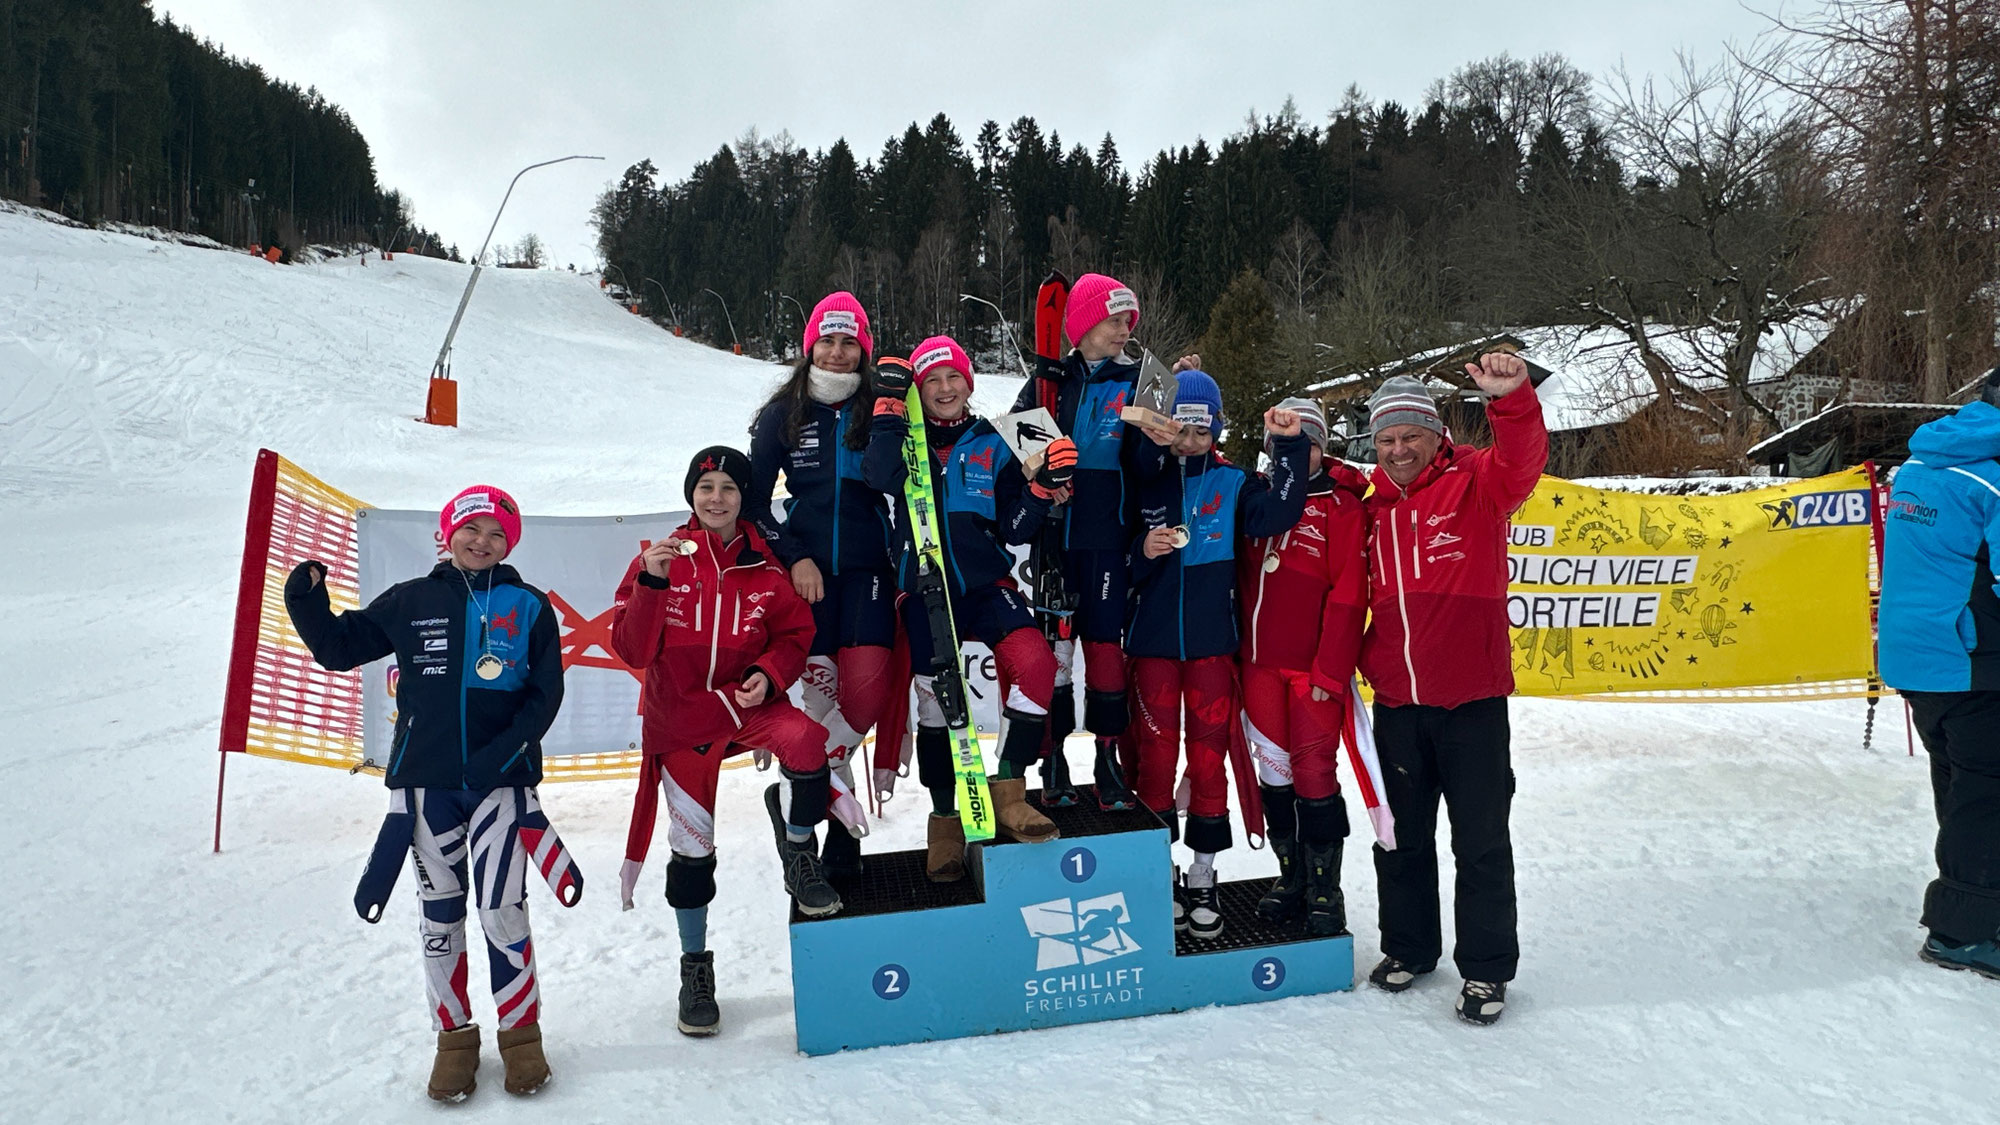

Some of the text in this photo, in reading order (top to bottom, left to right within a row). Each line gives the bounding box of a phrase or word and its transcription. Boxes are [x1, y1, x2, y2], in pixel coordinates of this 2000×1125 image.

[902, 405, 923, 488] FISCHE
[1796, 492, 1867, 526] CLUB
[1507, 527, 1546, 547] UB
[1609, 558, 1692, 585] VIELE
[1070, 853, 1083, 876] 1
[884, 970, 900, 993] 2
[1025, 967, 1144, 997] SCHILIFT
[1261, 963, 1277, 985] 3
[1025, 988, 1144, 1014] FREISTADT
